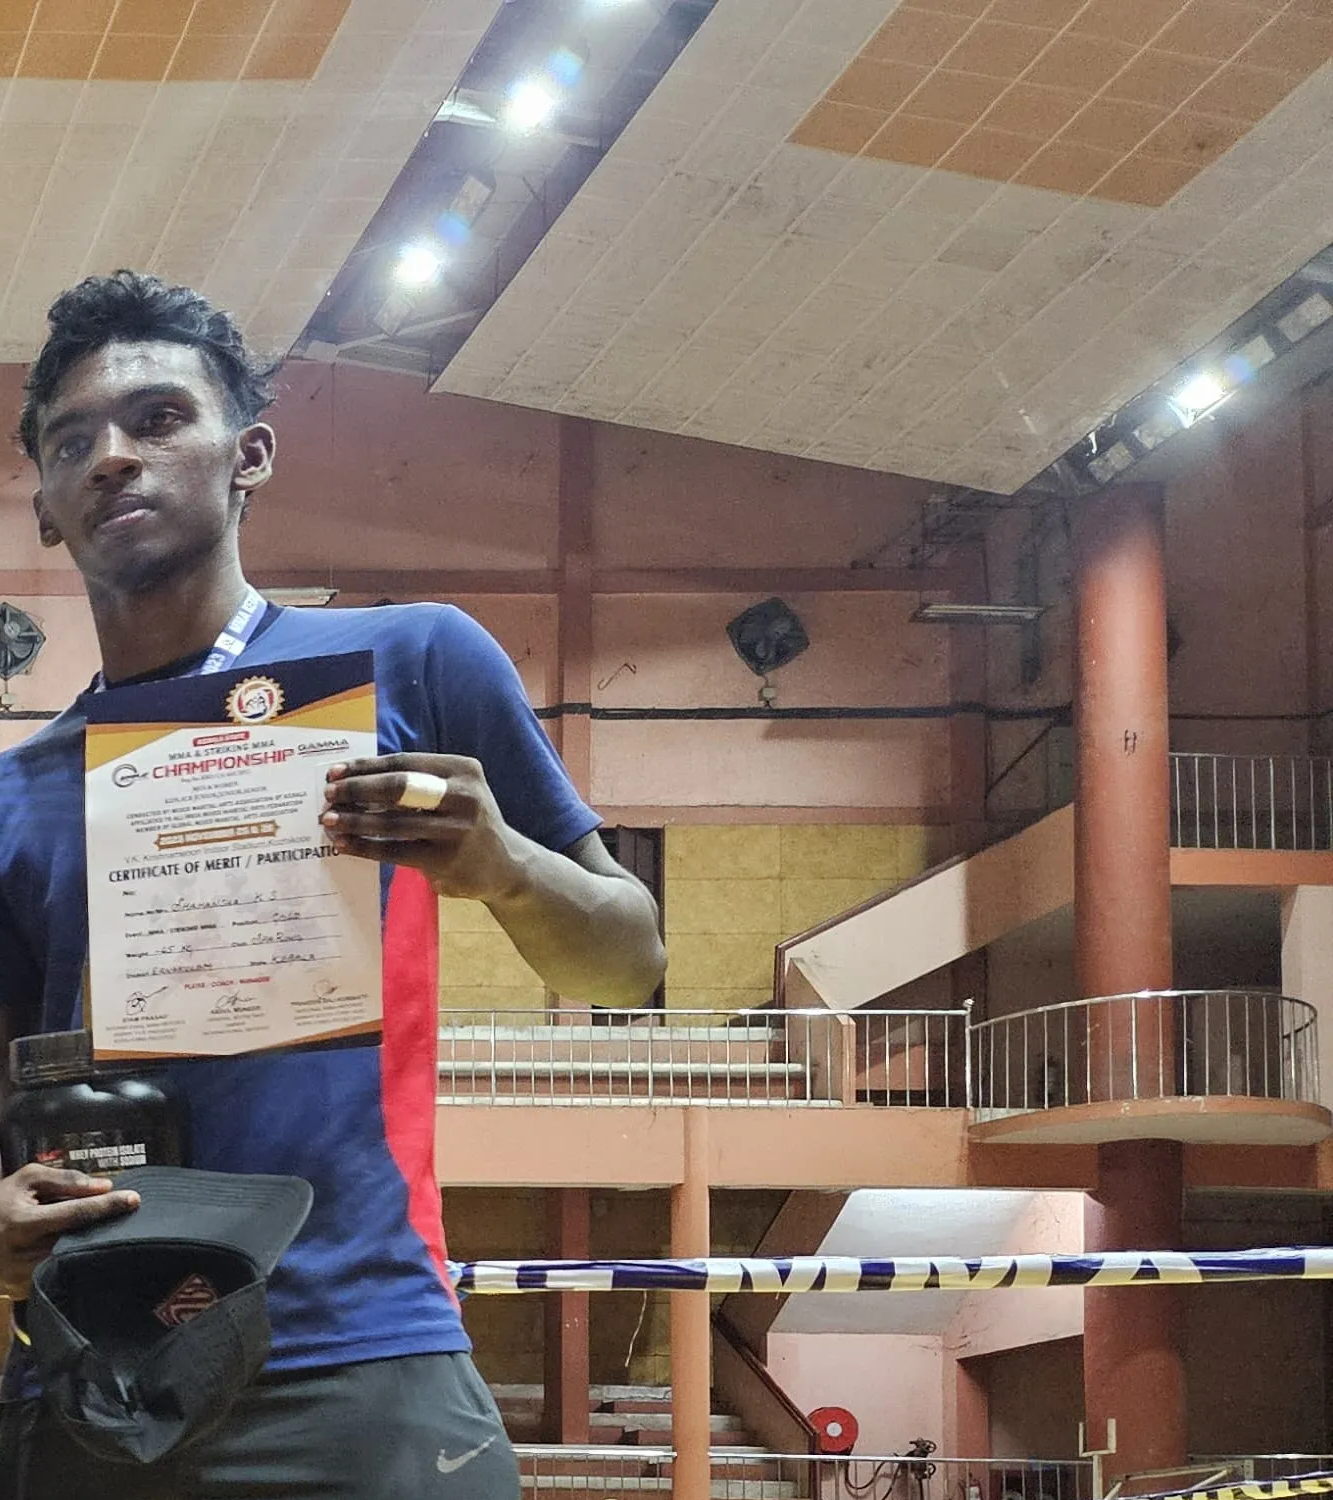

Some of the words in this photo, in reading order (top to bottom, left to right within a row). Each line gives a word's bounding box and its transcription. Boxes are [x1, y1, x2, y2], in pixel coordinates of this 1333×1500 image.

[168, 750, 191, 761] MMA
[194, 749, 201, 758] &
[203, 742, 249, 757] STRIKING
[251, 739, 275, 751] MMA
[296, 737, 349, 753] GAMMA
[152, 747, 294, 779] CHAMPIONSHIP
[108, 861, 181, 883] CERTIFICATE
[183, 860, 199, 876] OF
[203, 855, 241, 874] MERIT
[256, 845, 340, 868] PARTICIPATIO
